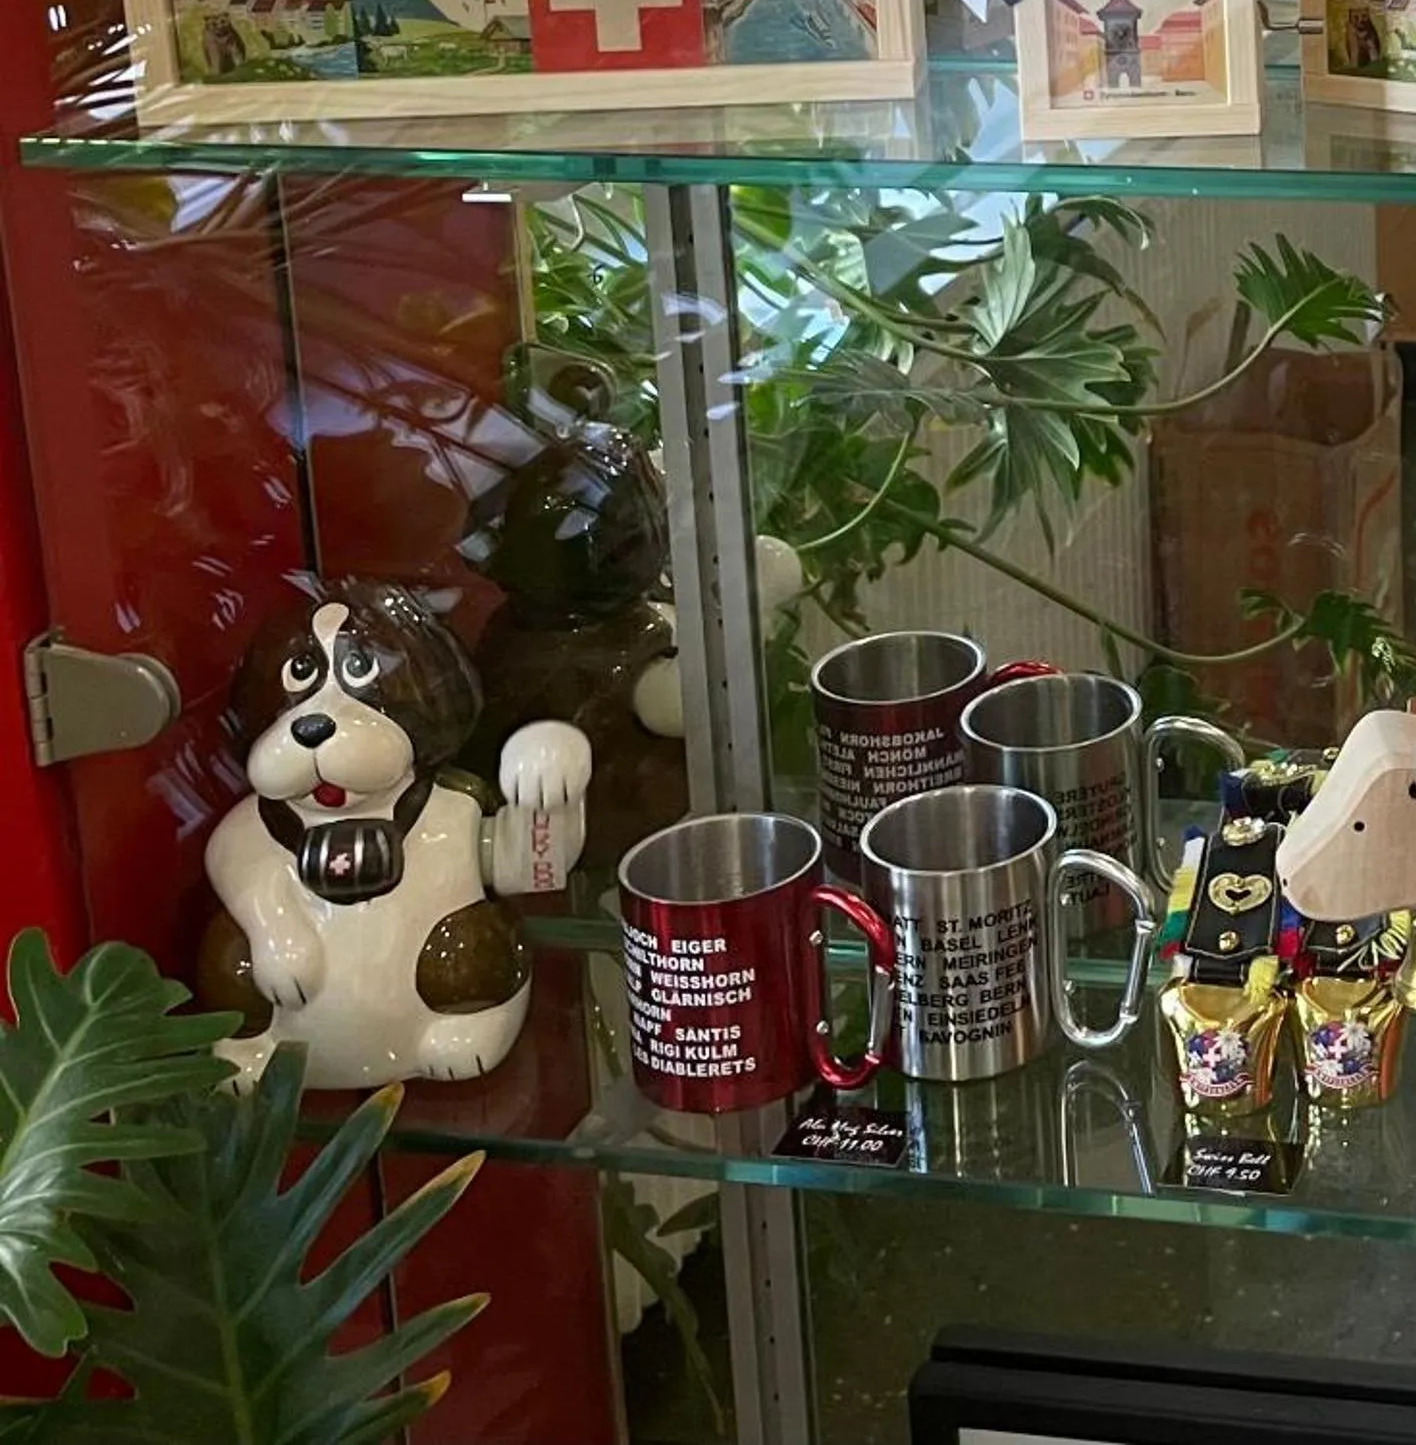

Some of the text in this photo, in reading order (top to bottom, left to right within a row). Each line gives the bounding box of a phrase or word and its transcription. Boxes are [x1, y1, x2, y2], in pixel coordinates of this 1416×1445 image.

[936, 919, 962, 934] ST.
[671, 938, 727, 954] EIGER
[921, 936, 982, 952] BASEL
[943, 937, 1038, 970] MEIRINGEN
[651, 968, 756, 990] WEISSHORN
[939, 972, 989, 990] SAAS
[995, 958, 1026, 981] FEE
[980, 978, 1028, 1004] BERN
[650, 1039, 738, 1060] RIGI KULM
[650, 1057, 757, 1078] DIABLERETS
[801, 1134, 884, 1152] CHF 11.00
[1186, 1164, 1222, 1177] CHF
